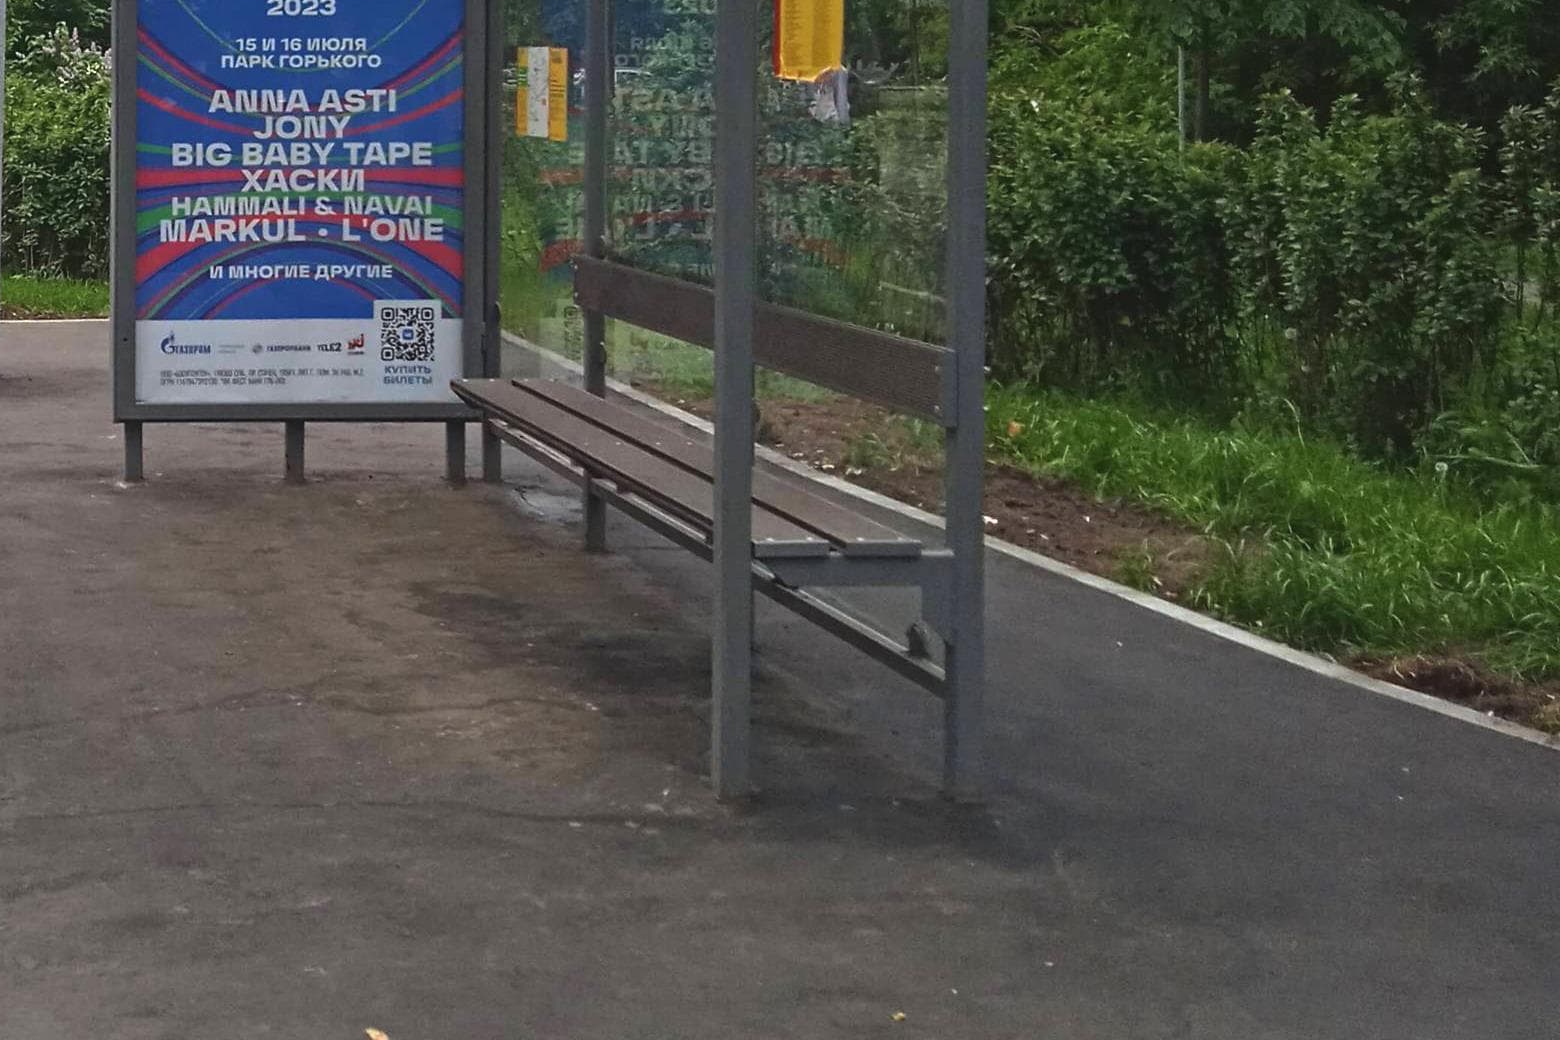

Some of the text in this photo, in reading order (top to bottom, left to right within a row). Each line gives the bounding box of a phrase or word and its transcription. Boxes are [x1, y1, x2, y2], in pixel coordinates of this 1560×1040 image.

[235, 38, 367, 52] 15 И 16 ИЮЛЯ
[221, 55, 382, 69] ПАРК ГОРЬКОГО
[208, 88, 397, 113] ANNA ASTI
[252, 115, 351, 140] JONY
[171, 142, 433, 167] BIG BABY TAPE
[241, 168, 365, 193] ХАСКИ
[171, 195, 432, 217] HAMMALI & NAVAI
[160, 217, 445, 243] MARKUL L'ONE
[209, 265, 393, 281] И МНОГИЕ ДРУГИЕ
[384, 365, 432, 374] КУПИТЬ
[383, 376, 433, 386] БИЛЕТЫ
